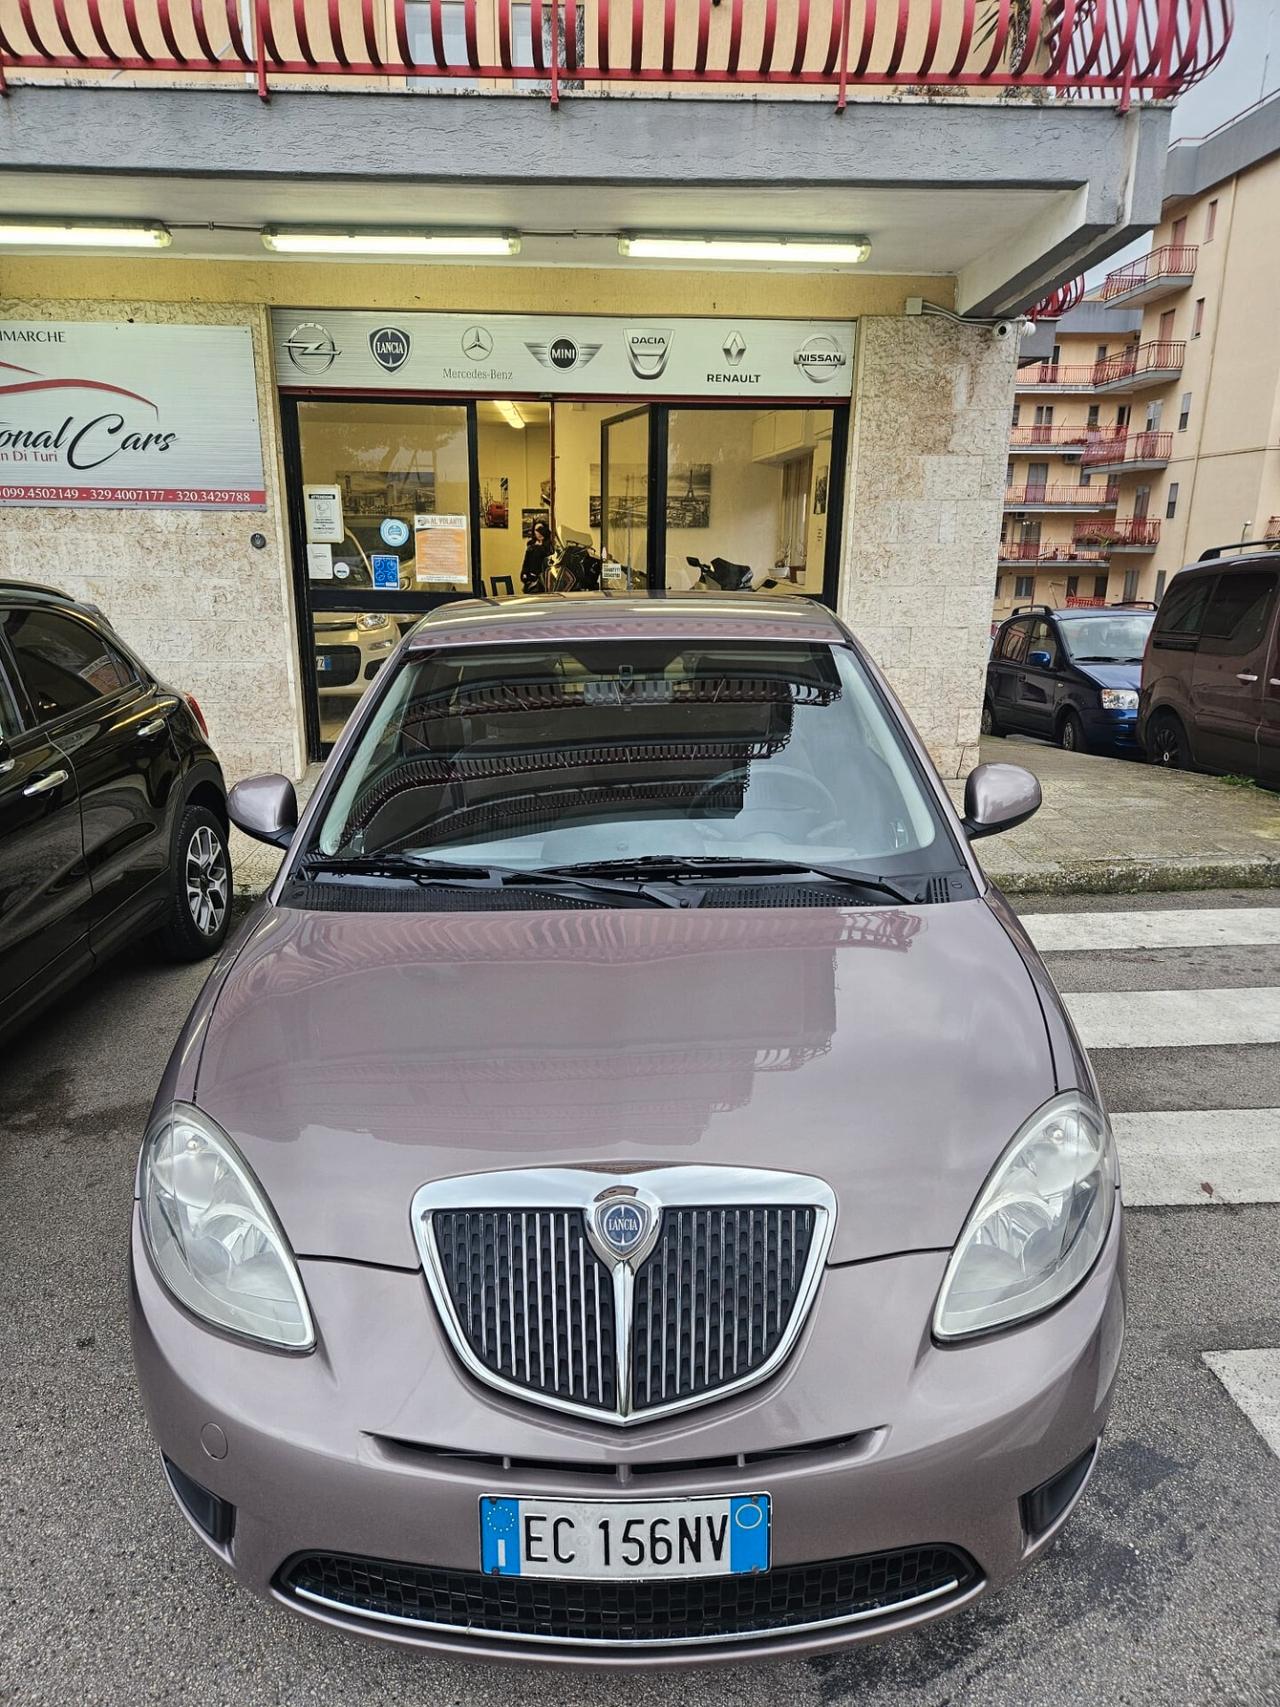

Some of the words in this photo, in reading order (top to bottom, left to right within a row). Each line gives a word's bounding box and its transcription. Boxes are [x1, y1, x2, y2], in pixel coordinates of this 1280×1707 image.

[631, 336, 666, 345] DACIA
[377, 341, 404, 355] LANCIA
[551, 347, 576, 360] MINI
[798, 353, 842, 363] NISSAN
[442, 367, 513, 381] Mercedes-Benz
[706, 373, 762, 384] RENAULT
[67, 413, 180, 470] Cars
[12, 450, 28, 462] Di
[32, 450, 58, 463] Turi
[2, 487, 79, 500] 099.4502149
[90, 489, 165, 501] 329.4007177
[176, 491, 251, 503] 320.3429788
[608, 1216, 638, 1231] LANCIA
[524, 1514, 576, 1564] EC
[598, 1513, 729, 1566] 156NV
